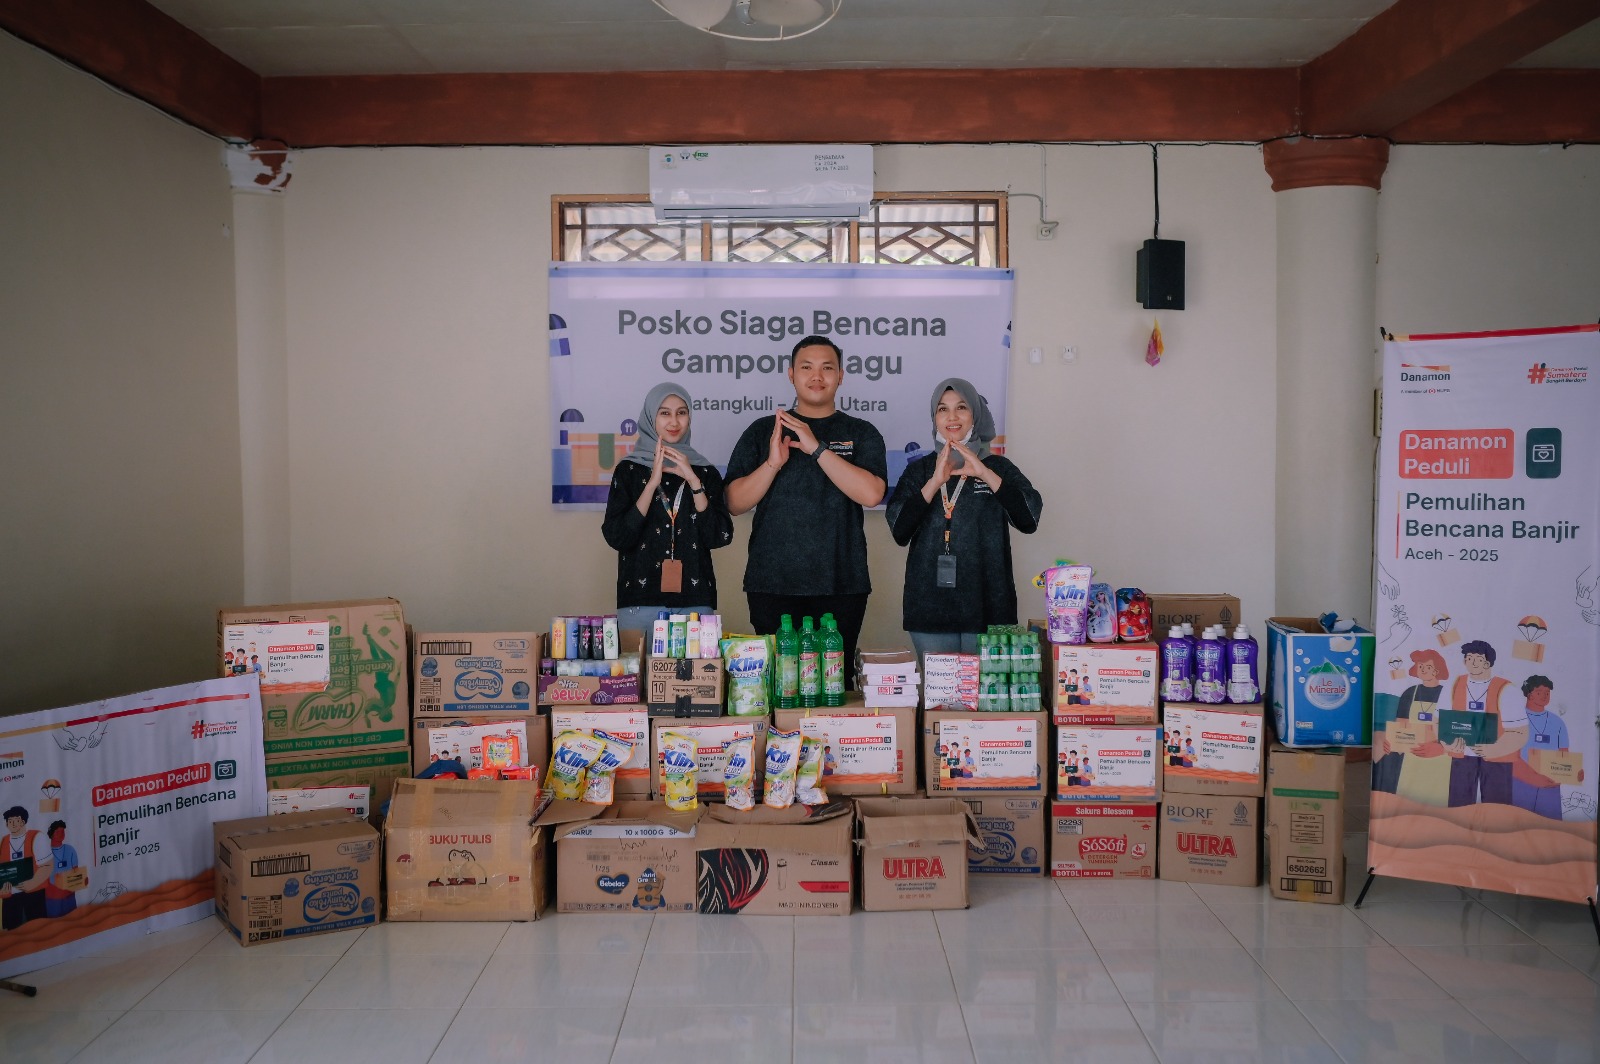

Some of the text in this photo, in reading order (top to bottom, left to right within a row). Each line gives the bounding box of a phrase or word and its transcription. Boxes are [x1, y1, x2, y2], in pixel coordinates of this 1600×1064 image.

[618, 309, 946, 342] Posko Siaga Bencana
[661, 348, 795, 379] Gampon
[1400, 372, 1451, 382] Danamon
[1547, 371, 1587, 379] Sumatera
[692, 396, 773, 411] atangkuli
[840, 396, 887, 412] Utara
[1405, 433, 1507, 450] Danamon
[1404, 457, 1470, 475] Peduli
[1406, 492, 1525, 511] Pemulihan
[1405, 519, 1580, 544] Bencana Banjir
[1405, 548, 1499, 562] Aceh 2025
[1053, 584, 1086, 600] Klin
[1158, 614, 1201, 625] BIORF
[352, 661, 393, 673] Kembali
[455, 658, 481, 670] Kering
[729, 657, 765, 672] Klin
[653, 683, 664, 693] 10
[1309, 686, 1346, 694] Minerale
[308, 702, 356, 720] CHARM
[271, 741, 293, 750] WING
[295, 740, 313, 748] NON
[315, 738, 335, 746] MAXI
[337, 735, 363, 744] EXTRA
[555, 746, 590, 769] Klin
[665, 749, 696, 768] Klin
[268, 766, 278, 774] BF
[95, 766, 207, 803] Danamon Peduli
[98, 789, 236, 828] Pemulihan Bencana
[1076, 807, 1133, 815] Sakura Blossom
[1167, 805, 1213, 819] BIORF
[99, 827, 140, 848] Banjir
[430, 835, 492, 845] BUKU TULIS
[1177, 832, 1238, 858] ULTRA
[100, 842, 160, 865] Aceh 2025
[883, 856, 946, 880] ULTRA
[1289, 865, 1325, 874] 6502662
[304, 873, 334, 887] Kering
[321, 887, 343, 898] pants
